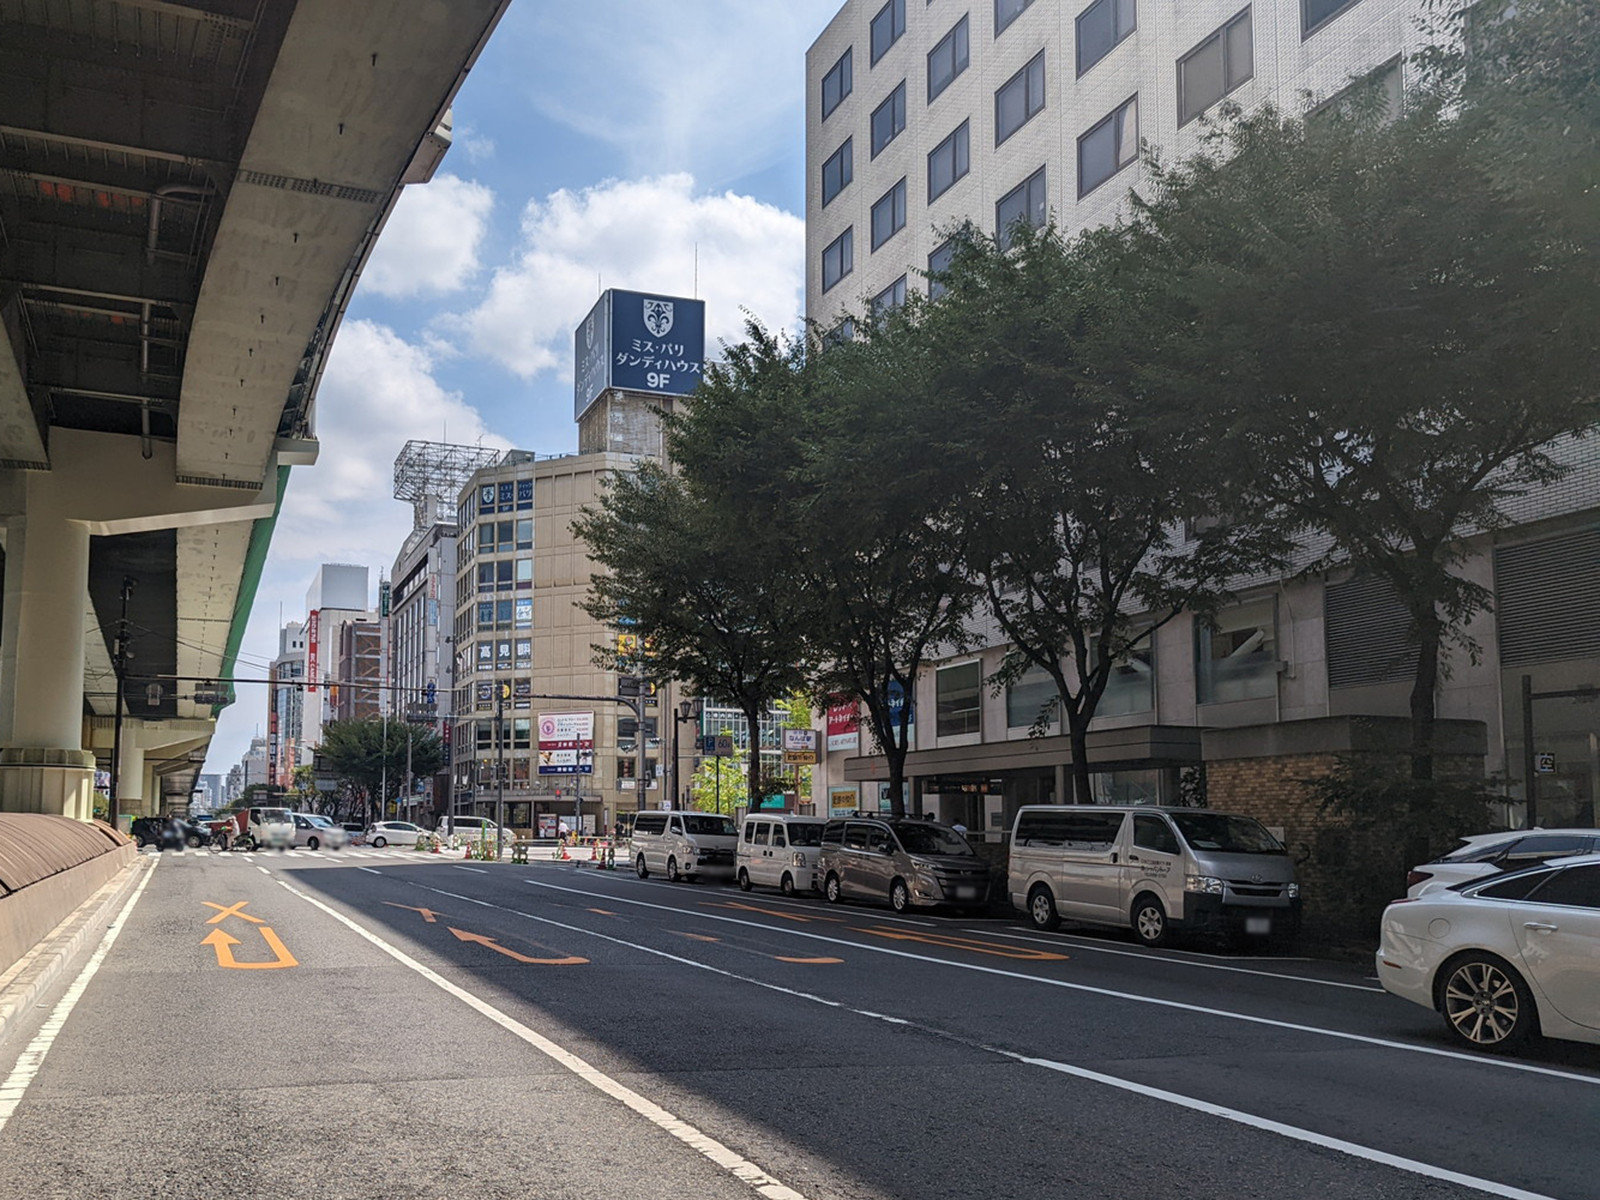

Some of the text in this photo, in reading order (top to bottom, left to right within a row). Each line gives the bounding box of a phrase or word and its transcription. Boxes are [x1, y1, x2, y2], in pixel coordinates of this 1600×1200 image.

[616, 352, 701, 374] ダンディハウス
[646, 372, 670, 388] 9F
